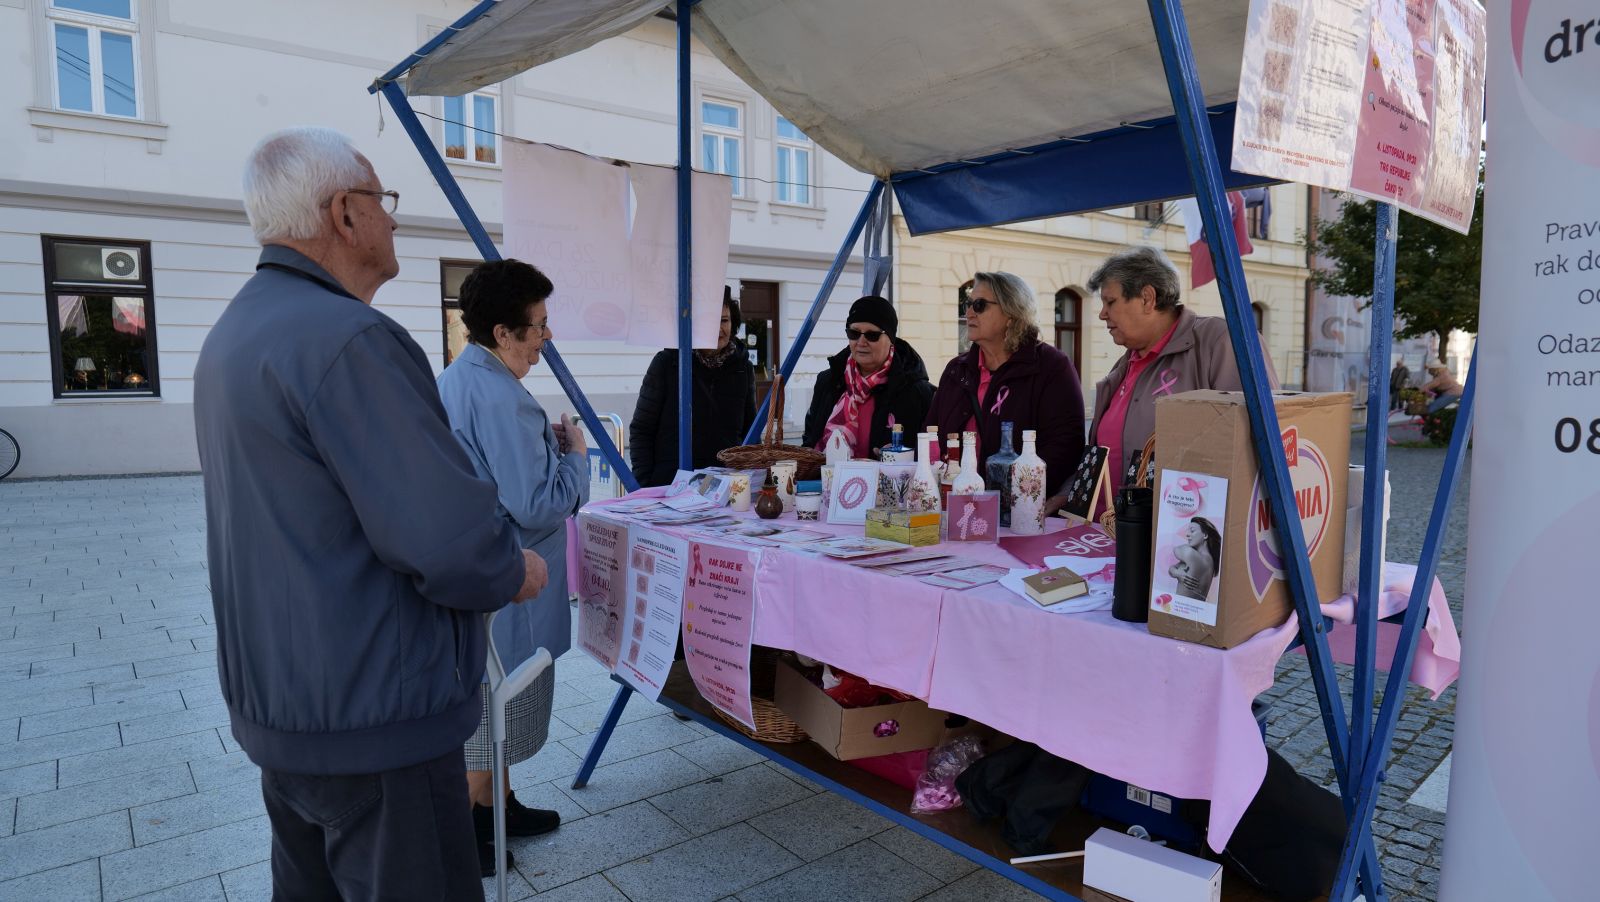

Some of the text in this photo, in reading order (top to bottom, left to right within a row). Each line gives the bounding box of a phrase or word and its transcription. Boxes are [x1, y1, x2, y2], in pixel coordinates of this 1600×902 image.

[1544, 19, 1600, 63] dr
[1380, 161, 1411, 180] TRG REPUBLIKE
[1385, 179, 1403, 196] ČAKOEC
[1534, 254, 1569, 277] rak
[1578, 288, 1600, 305] o
[1257, 485, 1322, 534] VINN
[719, 560, 734, 570] DOJKE
[736, 563, 743, 571] NE
